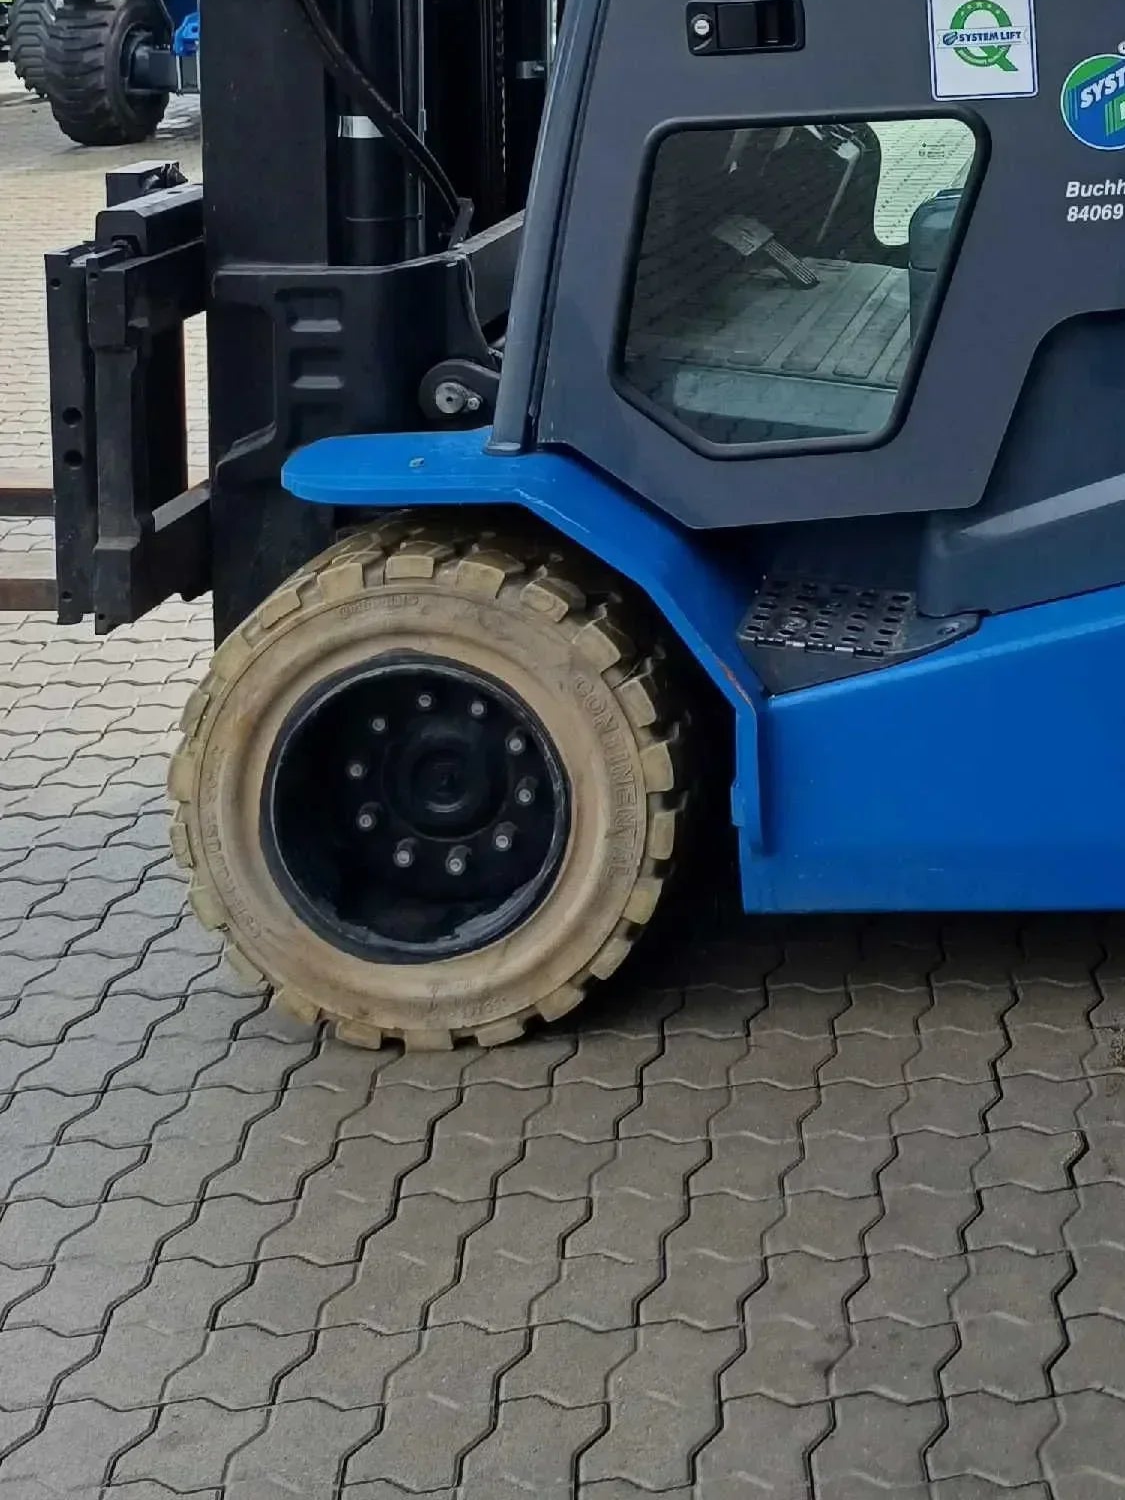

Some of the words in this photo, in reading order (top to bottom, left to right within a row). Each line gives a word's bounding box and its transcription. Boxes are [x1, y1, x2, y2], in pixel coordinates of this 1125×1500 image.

[959, 32, 999, 42] SYSTEM
[1000, 31, 1021, 40] LIFT
[1067, 203, 1124, 222] 84069
